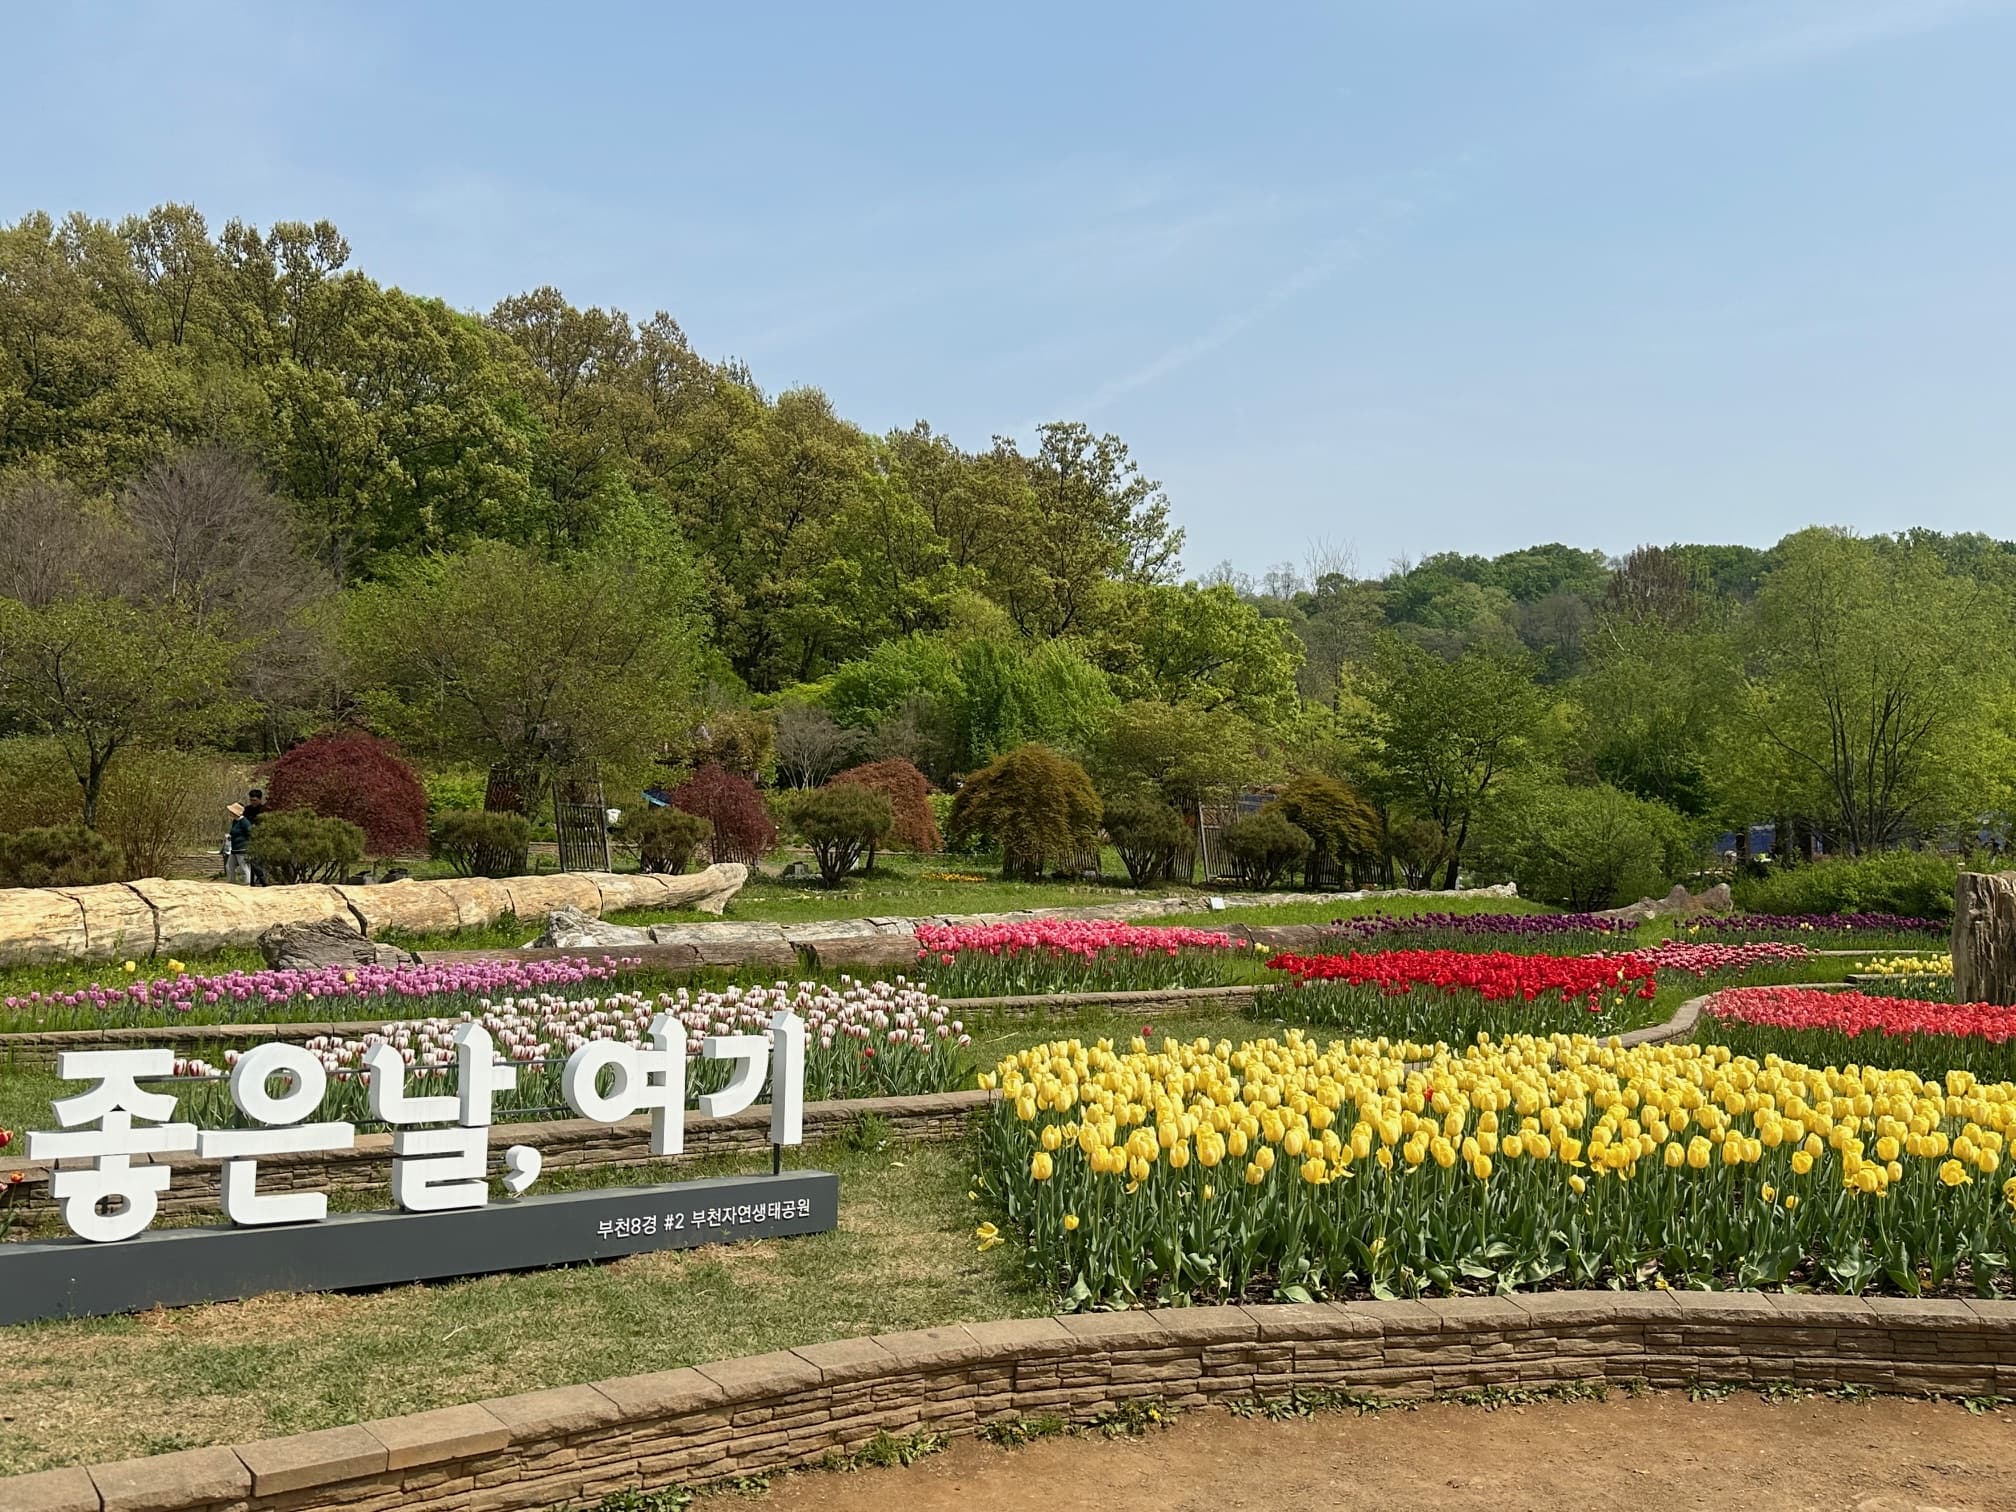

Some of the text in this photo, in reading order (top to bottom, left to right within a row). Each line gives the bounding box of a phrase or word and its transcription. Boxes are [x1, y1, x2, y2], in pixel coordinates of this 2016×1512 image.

[563, 1010, 805, 1155] 여기
[597, 1198, 811, 1239] 부천8경 #2 부천자연생태공원
